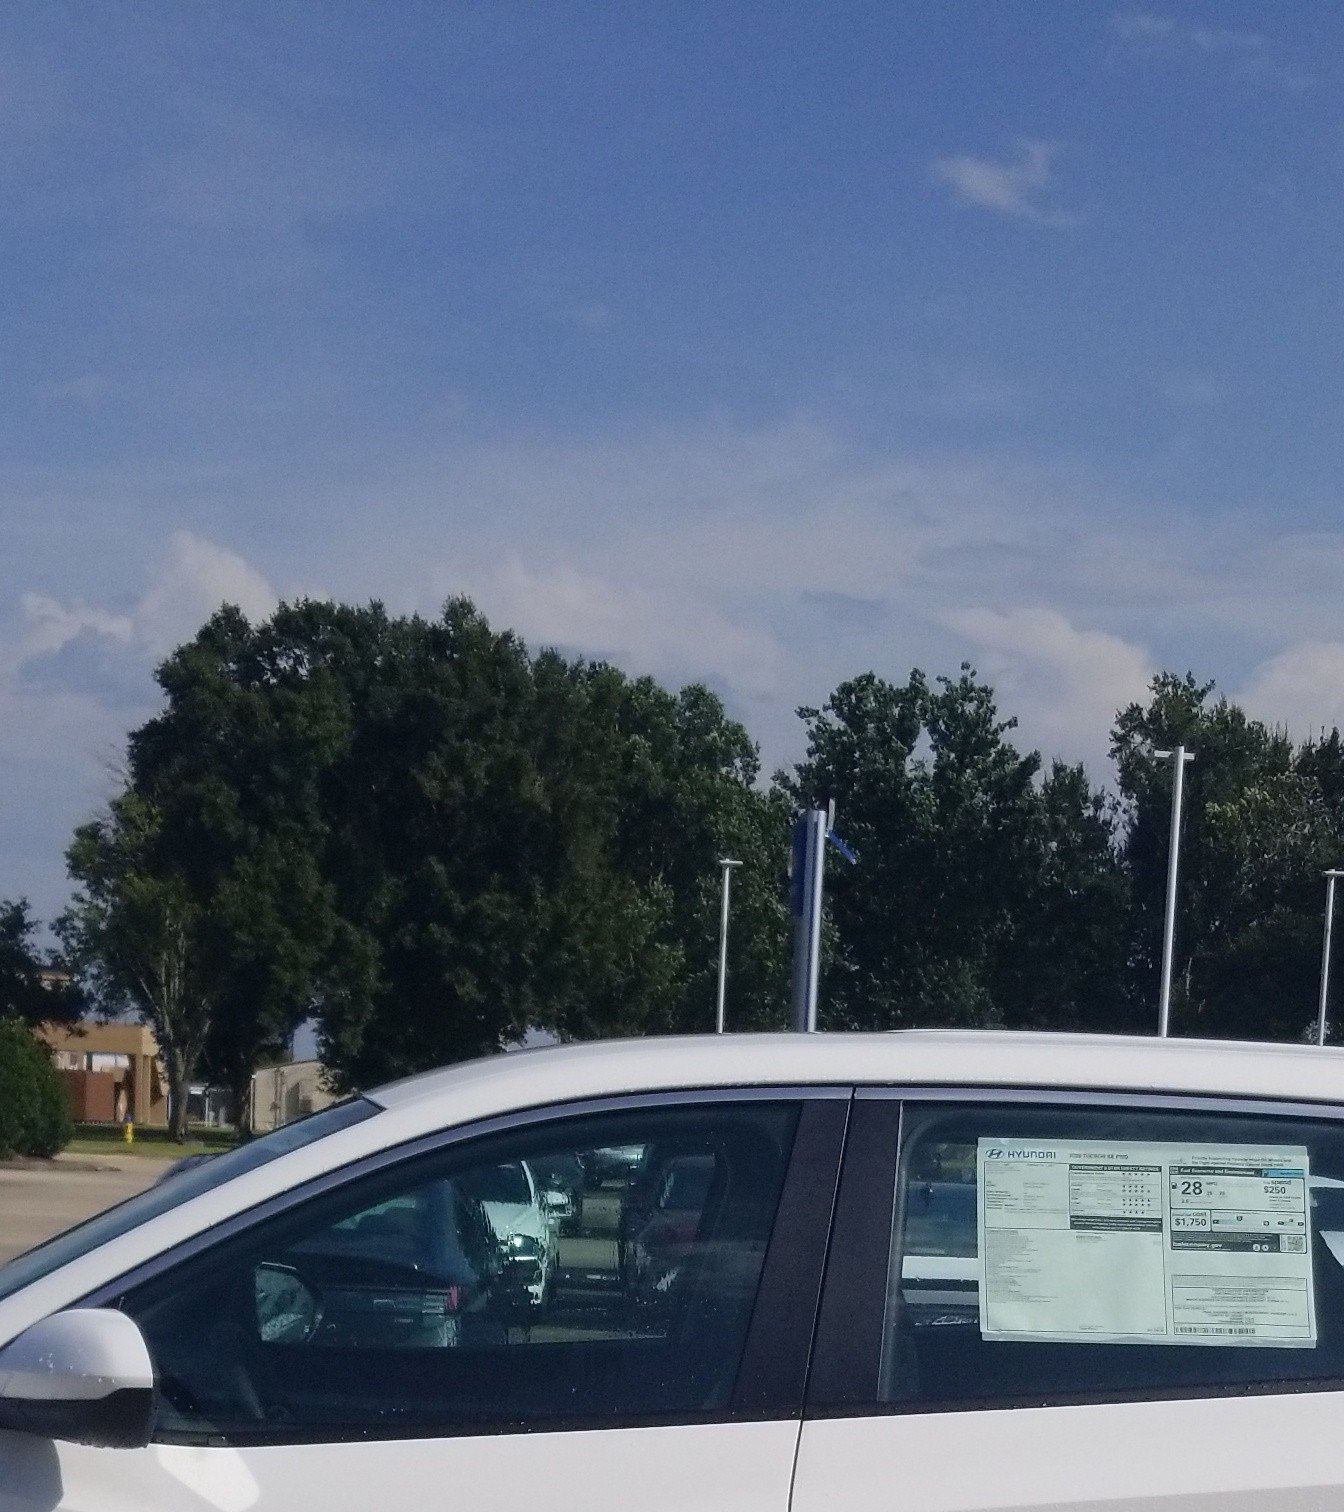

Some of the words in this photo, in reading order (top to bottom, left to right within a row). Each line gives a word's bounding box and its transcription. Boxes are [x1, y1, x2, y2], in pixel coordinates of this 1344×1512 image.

[1008, 1151, 1056, 1159] HYUNDAI
[1181, 1181, 1203, 1195] 28
[1263, 1185, 1286, 1195] $250
[1174, 1218, 1207, 1227] $1,750
